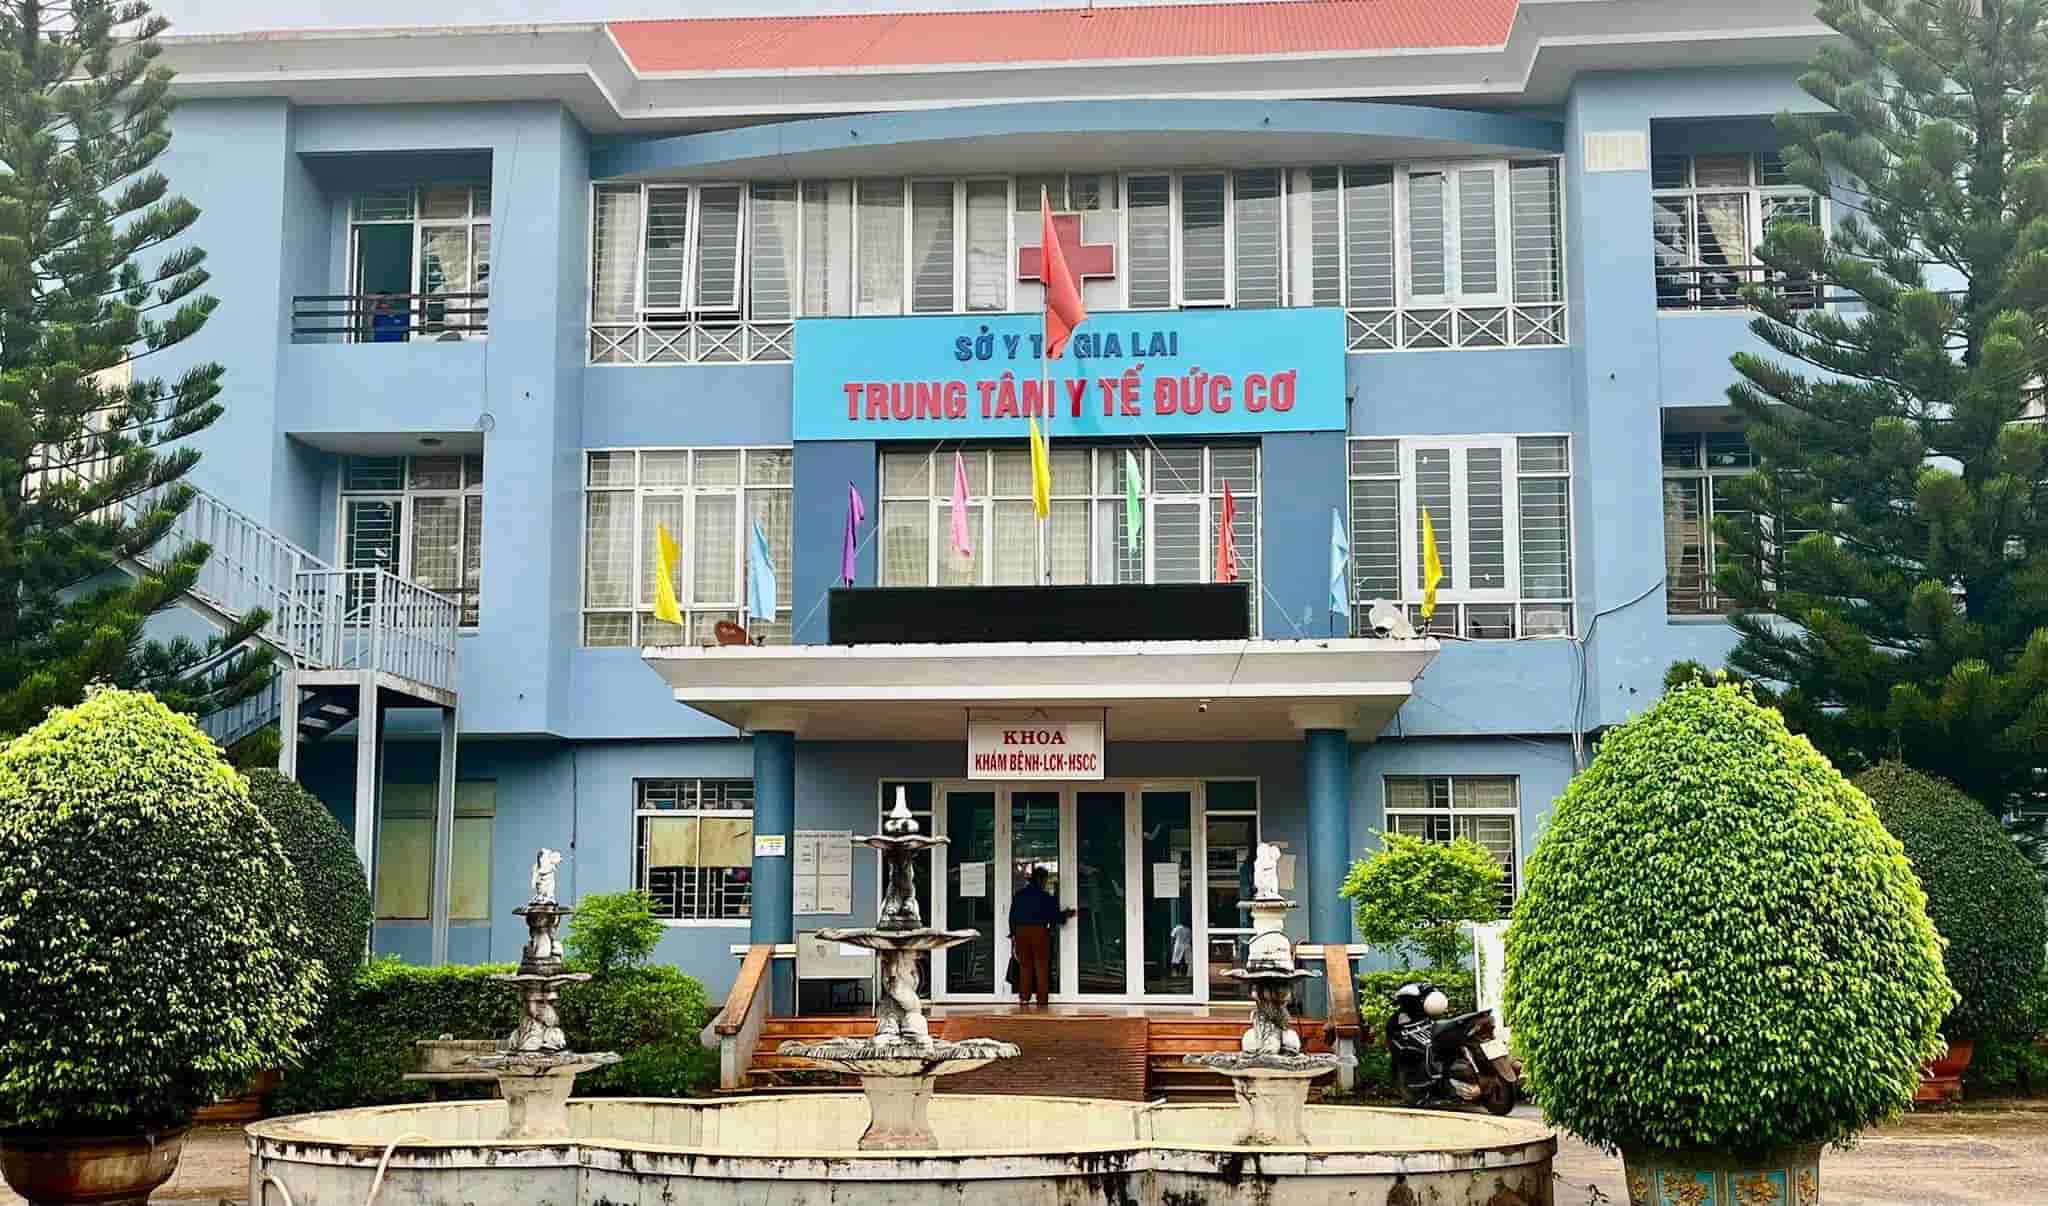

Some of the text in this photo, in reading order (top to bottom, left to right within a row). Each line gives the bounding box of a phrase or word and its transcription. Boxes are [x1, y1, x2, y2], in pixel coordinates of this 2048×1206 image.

[955, 325, 994, 361] SỞ
[1004, 334, 1020, 360] Y
[1073, 332, 1121, 360] GIA
[1131, 331, 1177, 358] LAI
[844, 362, 1298, 421] TRUNG TÂM Y TẾ ĐỨC CƠ
[1002, 730, 1066, 745] KHOA
[975, 749, 1007, 772] KHÁM
